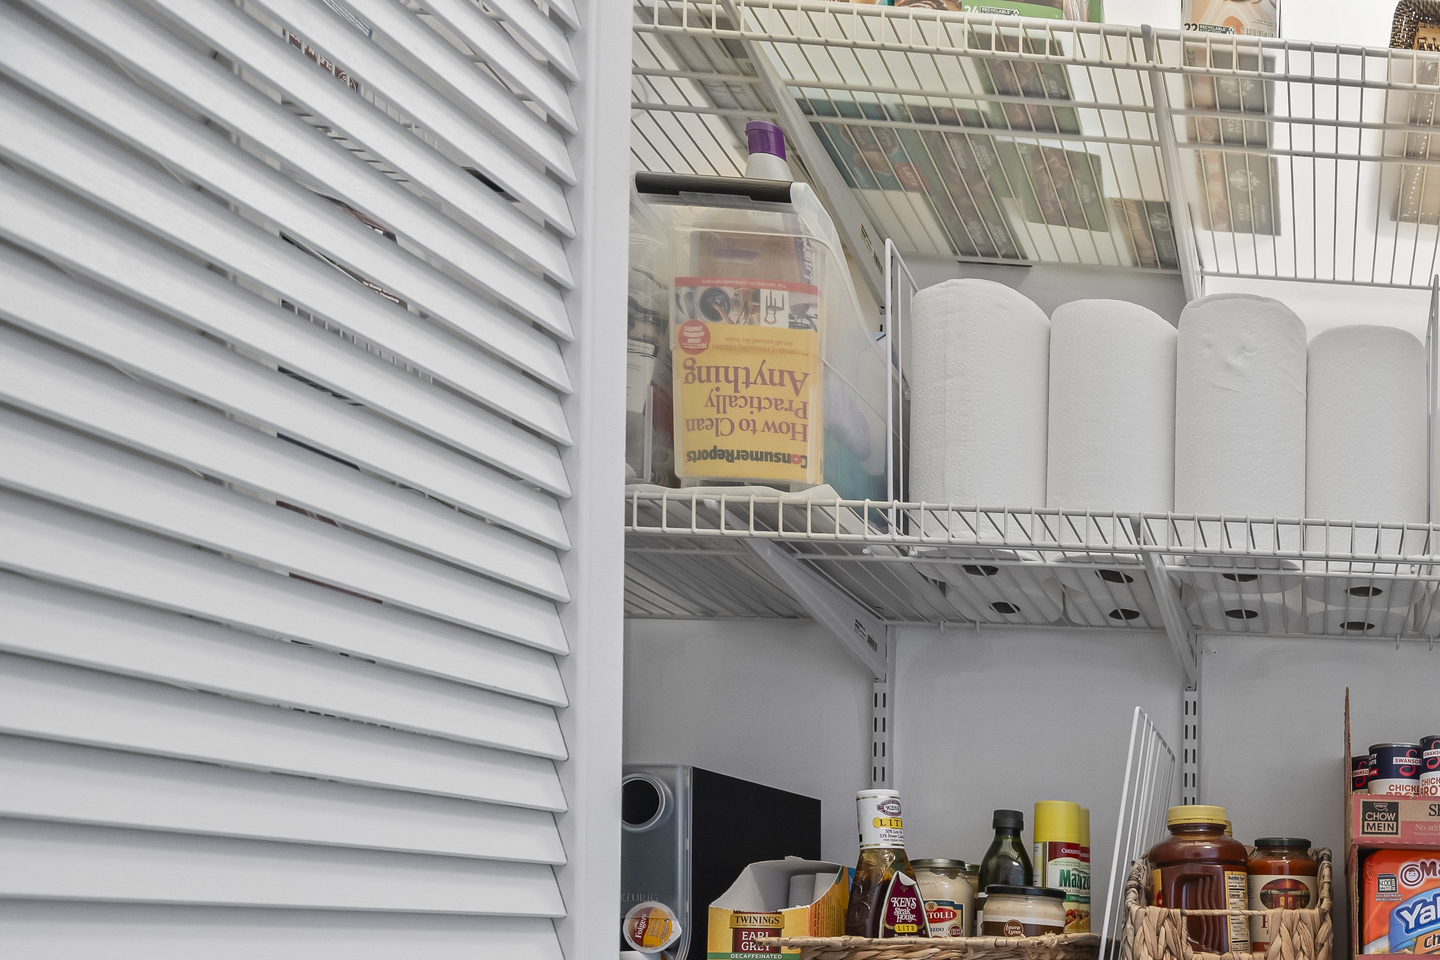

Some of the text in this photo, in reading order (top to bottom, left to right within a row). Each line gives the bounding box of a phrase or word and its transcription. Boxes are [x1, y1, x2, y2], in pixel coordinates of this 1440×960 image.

[682, 357, 810, 397] Anything
[704, 386, 809, 420] Practically
[685, 417, 809, 443] How to Clean
[686, 445, 808, 469] ConsumerReports
[1388, 784, 1420, 792] CHICKE
[1365, 812, 1396, 821] CHOW
[1365, 822, 1397, 832] MEIN
[890, 897, 917, 909] KEN'S
[893, 907, 911, 915] Steak
[926, 911, 953, 919] TOLLI
[735, 915, 780, 925] TWININGS
[896, 914, 917, 923] House
[634, 914, 648, 939] Folgers
